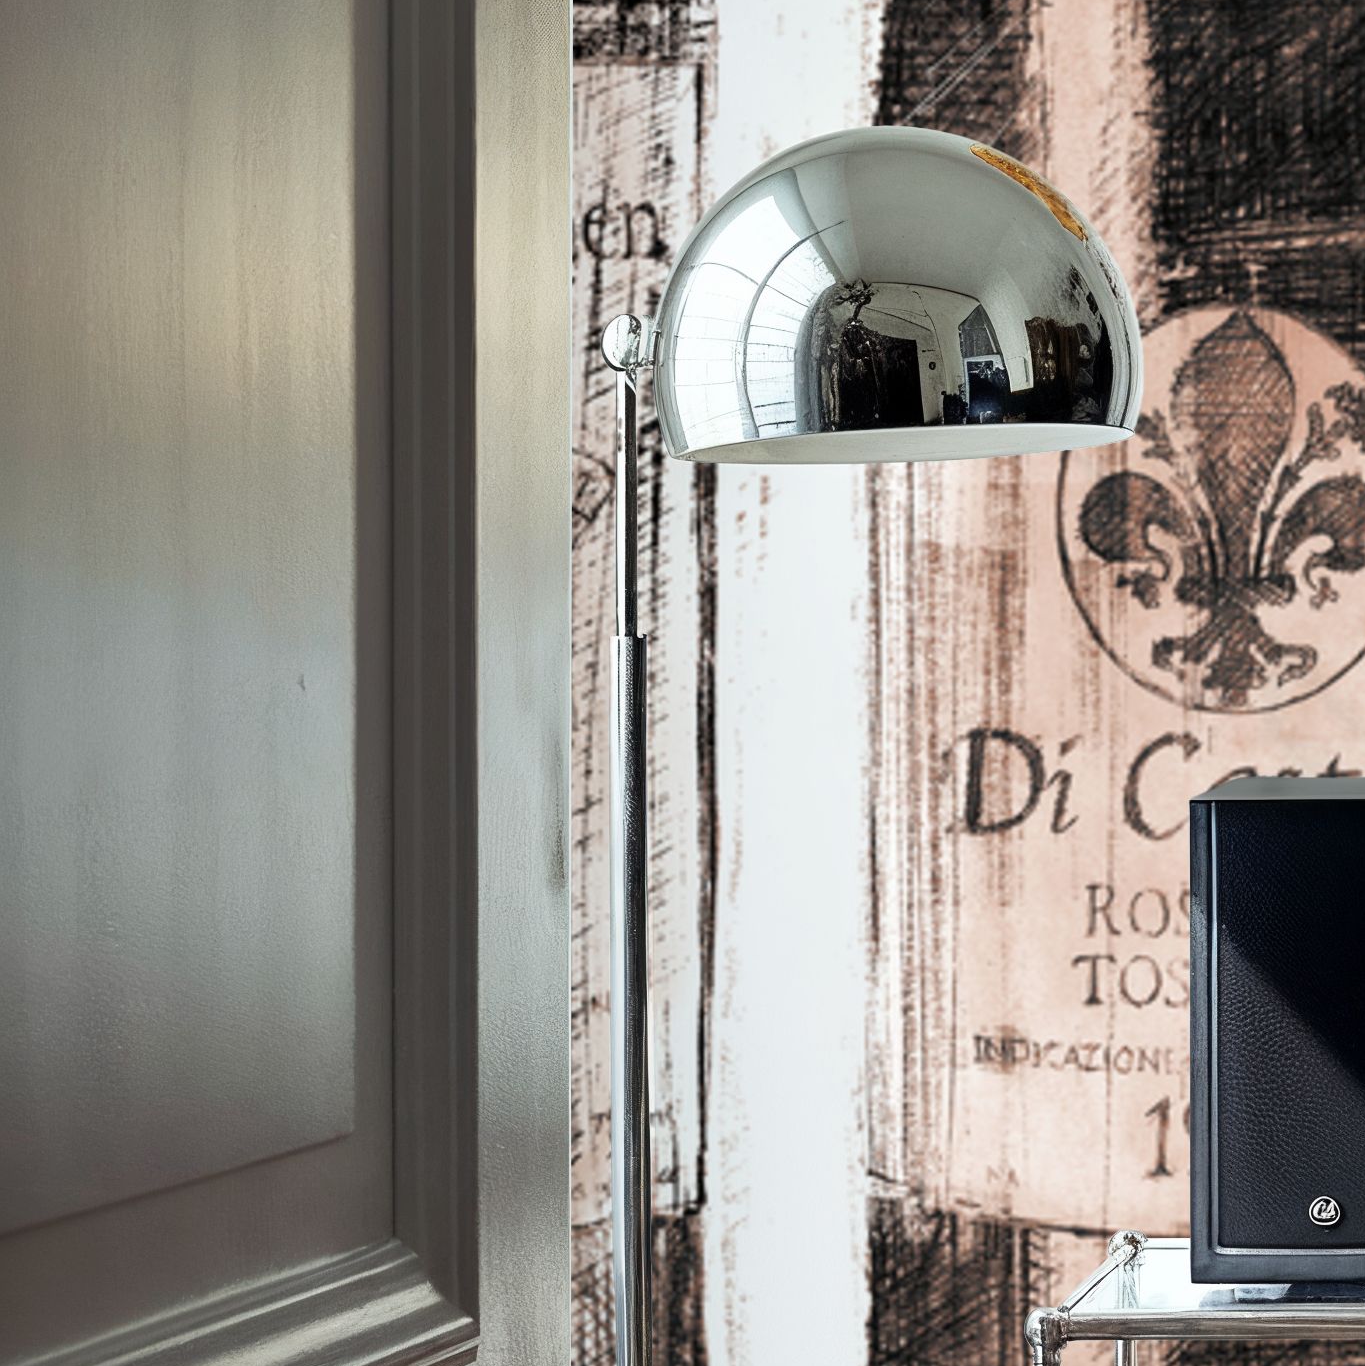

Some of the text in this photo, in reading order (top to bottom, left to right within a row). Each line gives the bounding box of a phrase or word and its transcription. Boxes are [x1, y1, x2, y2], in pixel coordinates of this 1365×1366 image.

[572, 201, 668, 261] en
[960, 727, 1079, 835] Di
[1144, 1095, 1191, 1179] 1
